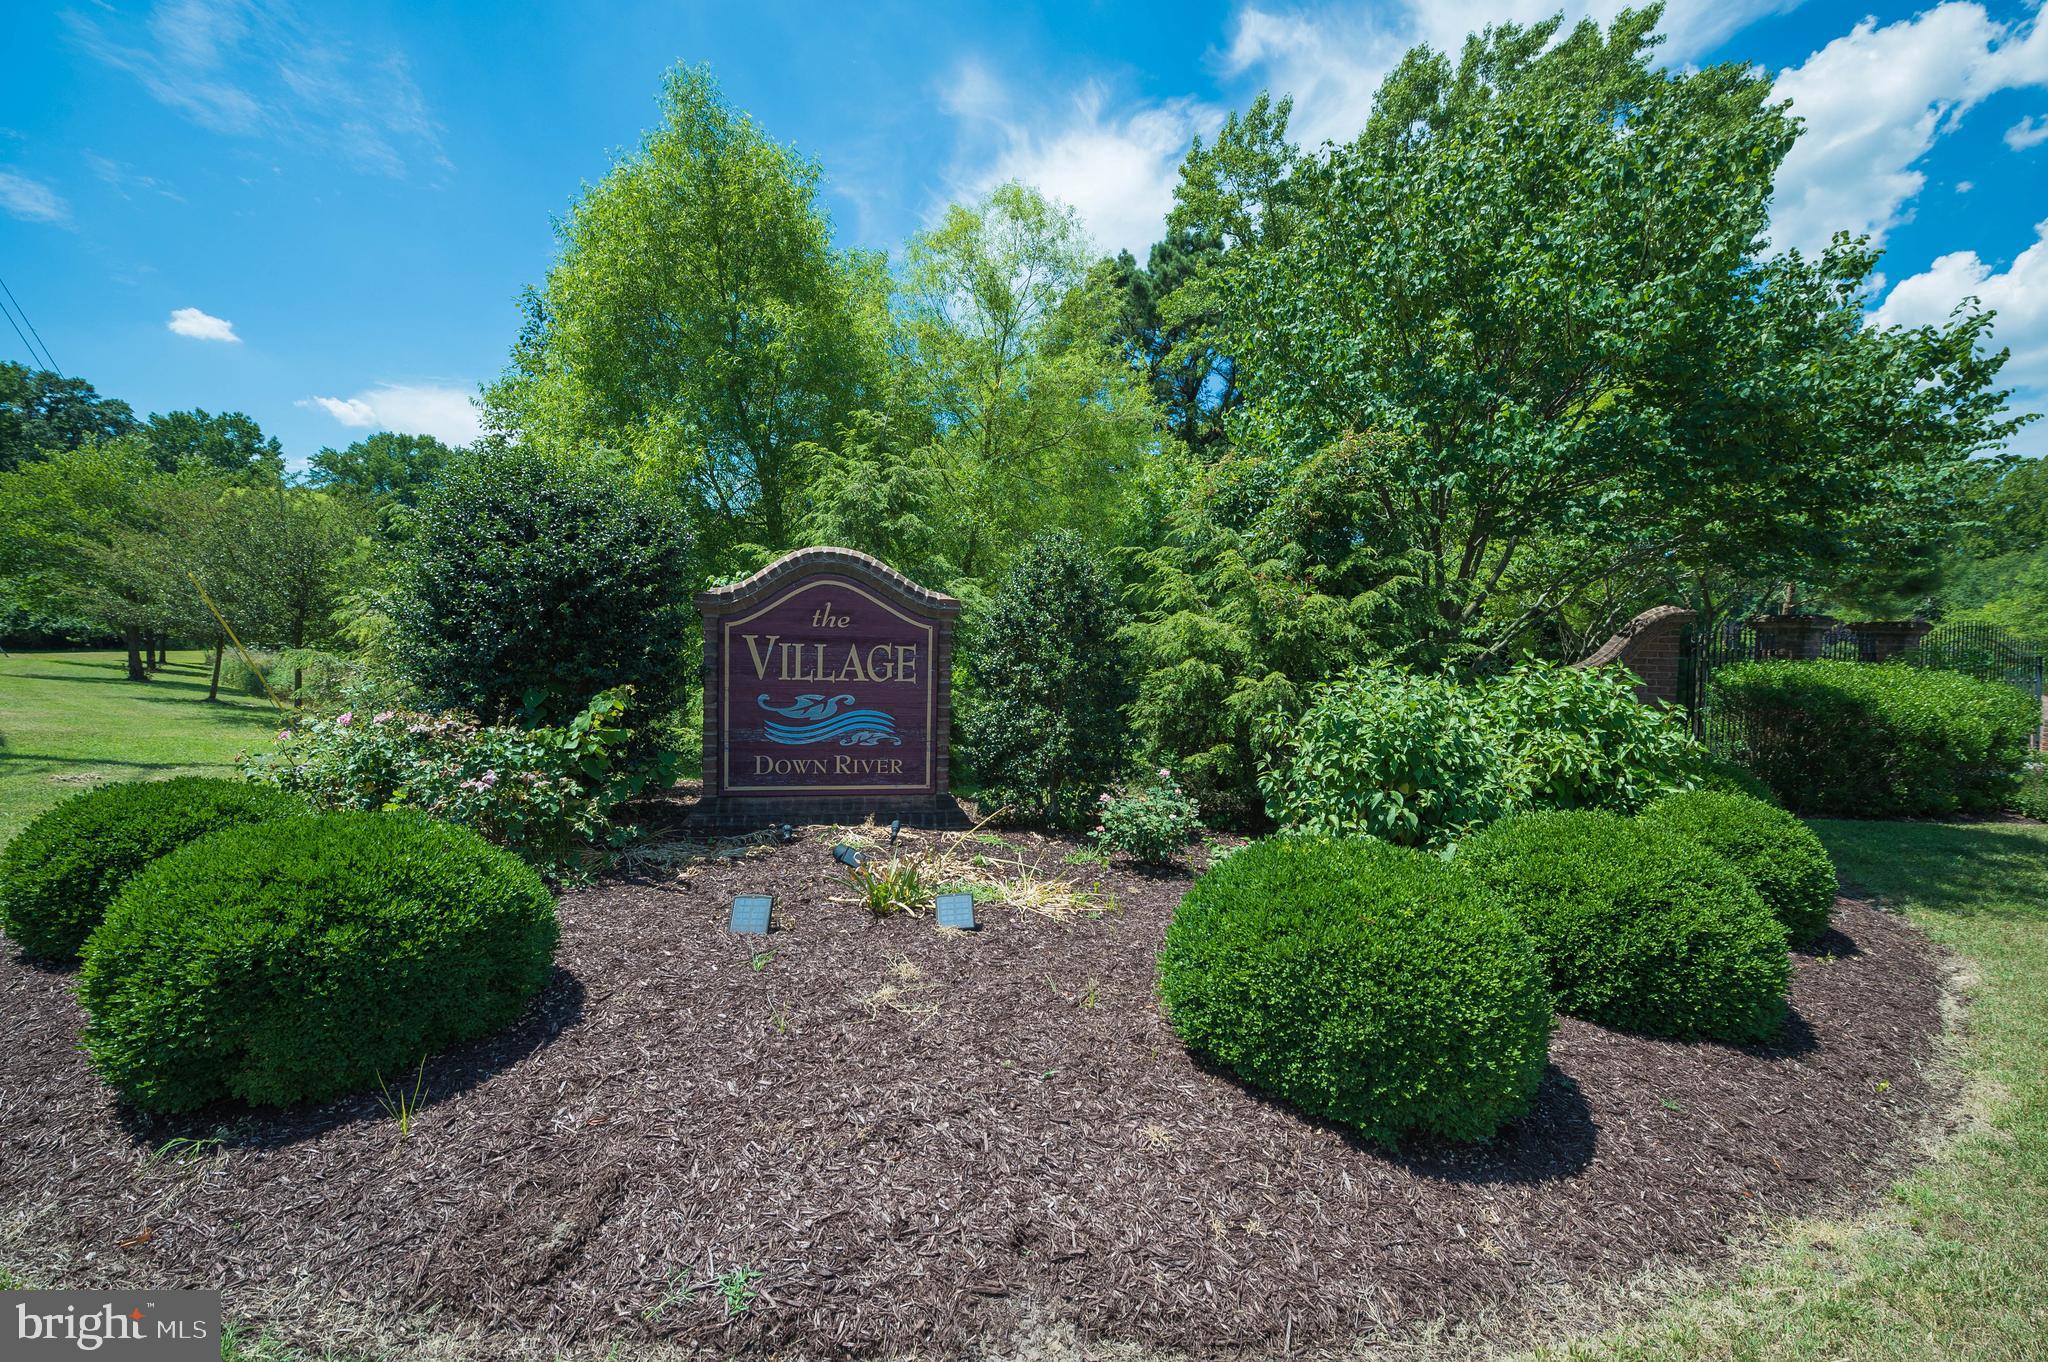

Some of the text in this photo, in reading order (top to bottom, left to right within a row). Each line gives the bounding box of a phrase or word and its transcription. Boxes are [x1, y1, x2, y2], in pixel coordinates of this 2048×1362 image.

[811, 601, 850, 629] the
[741, 634, 918, 685] VILLAGE
[753, 754, 904, 776] DOWN RIVER
